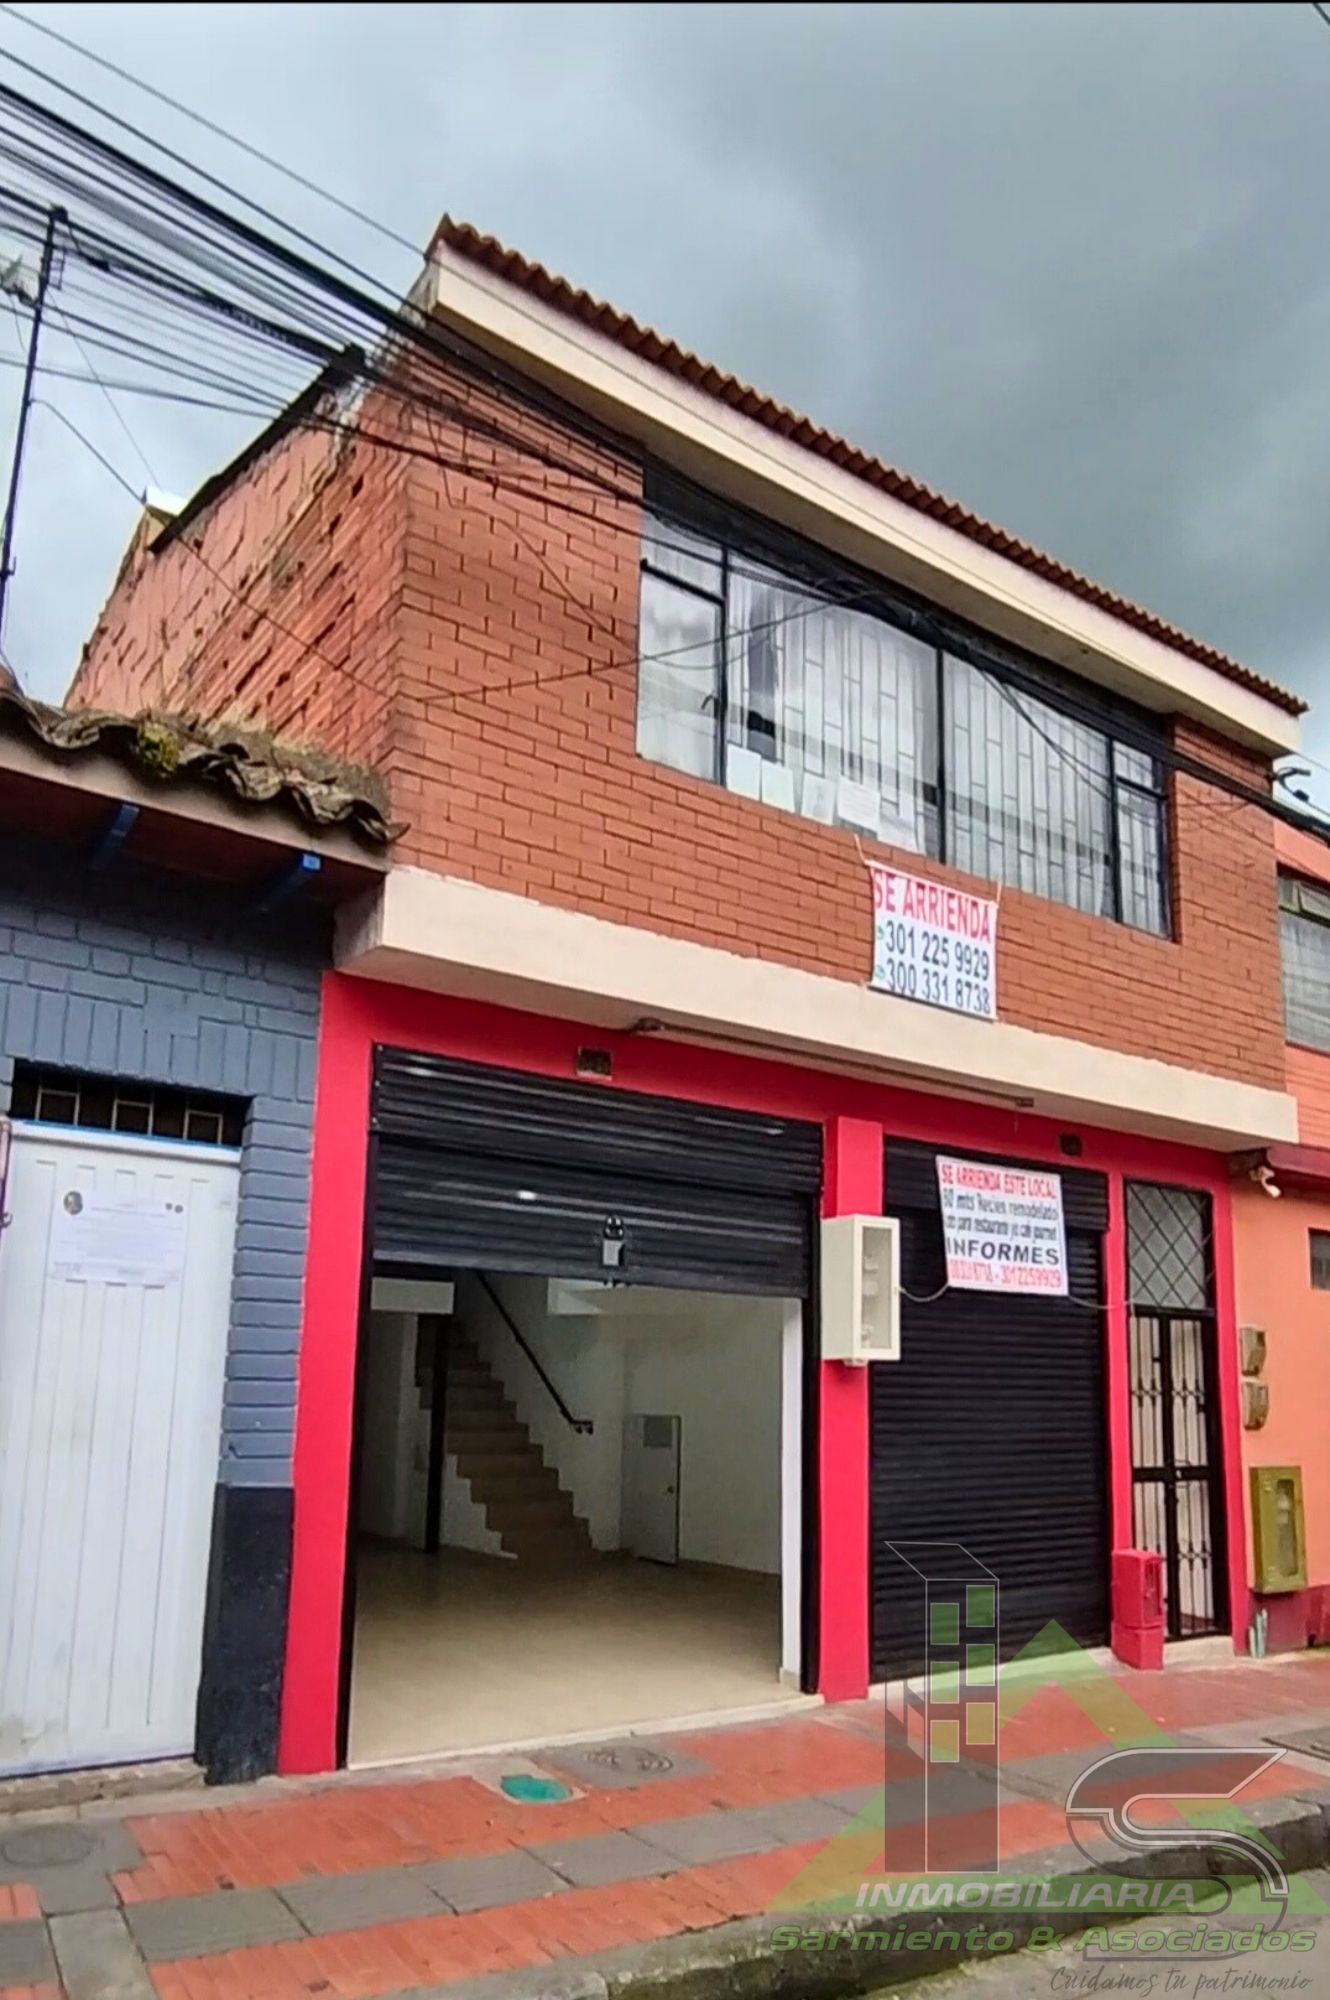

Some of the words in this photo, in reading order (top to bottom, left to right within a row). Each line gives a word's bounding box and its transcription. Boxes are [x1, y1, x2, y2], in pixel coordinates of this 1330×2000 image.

[873, 869, 896, 913] SE
[903, 877, 991, 943] ARRIENDA
[886, 920, 915, 958] 301
[921, 931, 949, 968] 225
[954, 941, 989, 981] 9929
[886, 958, 917, 996] 300
[922, 969, 949, 1003] 331
[942, 1164, 953, 1184] SE
[947, 1237, 1059, 1265] INFORMES
